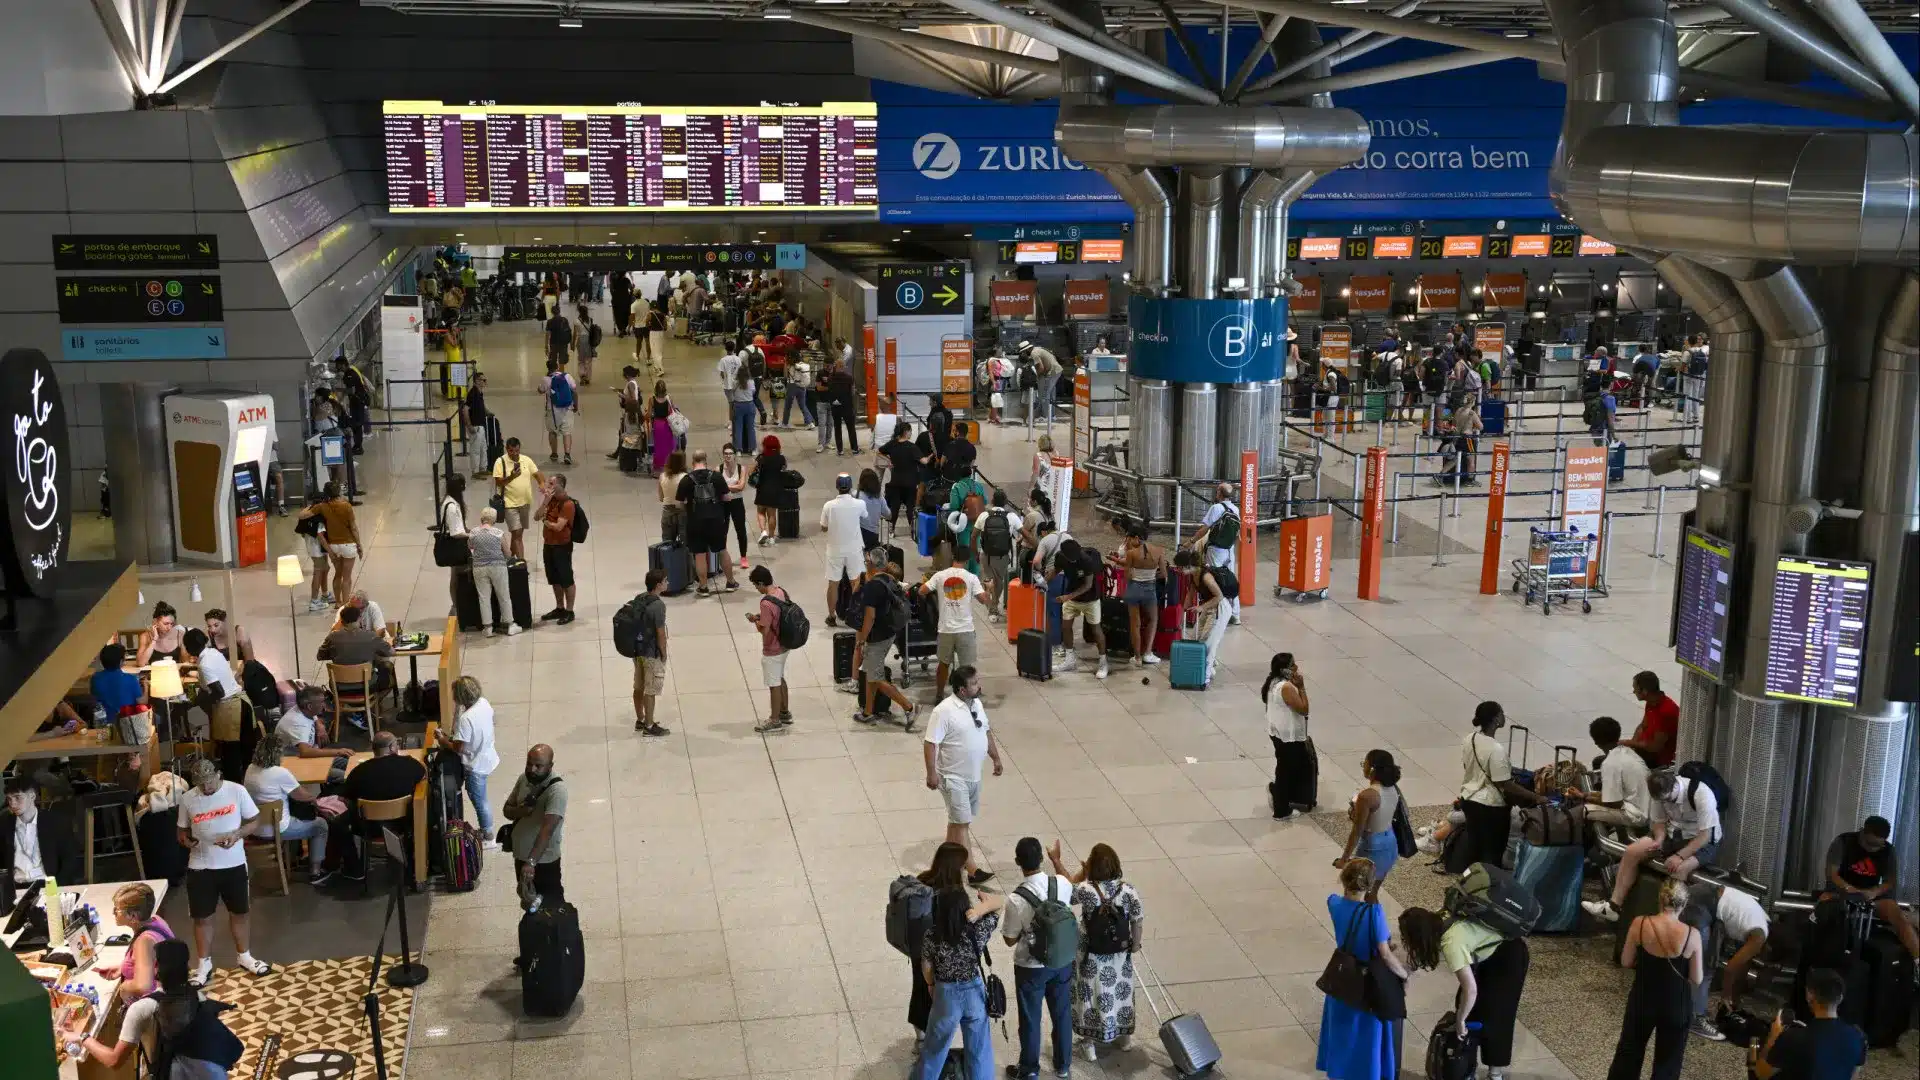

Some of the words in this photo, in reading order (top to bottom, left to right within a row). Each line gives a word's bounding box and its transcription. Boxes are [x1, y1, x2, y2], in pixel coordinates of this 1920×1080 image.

[1369, 118, 1440, 138] mos,
[978, 146, 1089, 171] ZURIC
[1394, 151, 1463, 169] corra
[1470, 145, 1530, 169] bem
[1031, 228, 1052, 236] check
[84, 243, 115, 252] portas
[117, 242, 129, 251] de
[131, 242, 181, 252] embarque
[1303, 243, 1338, 252] easyJet
[1348, 242, 1367, 257] 19
[1421, 242, 1441, 257] 20
[1490, 240, 1508, 256] 21
[1553, 239, 1573, 254] 22
[84, 252, 127, 262] boarding
[129, 252, 154, 262] gates
[558, 251, 592, 259] embarque
[88, 284, 115, 293] check
[118, 284, 127, 293] in
[904, 287, 916, 304] B
[995, 293, 1030, 302] easyJet
[1069, 292, 1104, 301] easyJet
[1160, 335, 1169, 343] in
[1225, 326, 1246, 357] B
[31, 368, 53, 426] to
[238, 406, 267, 424] ATM
[1368, 456, 1376, 475] DROP
[1495, 453, 1505, 471] DROP
[1567, 455, 1604, 465] easyJet
[1245, 463, 1254, 492] BOARDING
[1367, 475, 1375, 489] BAG
[1494, 472, 1503, 485] BAG
[1245, 492, 1254, 514] SPEEDY
[1288, 534, 1297, 582] easyJet
[1314, 535, 1323, 583] easyJet
